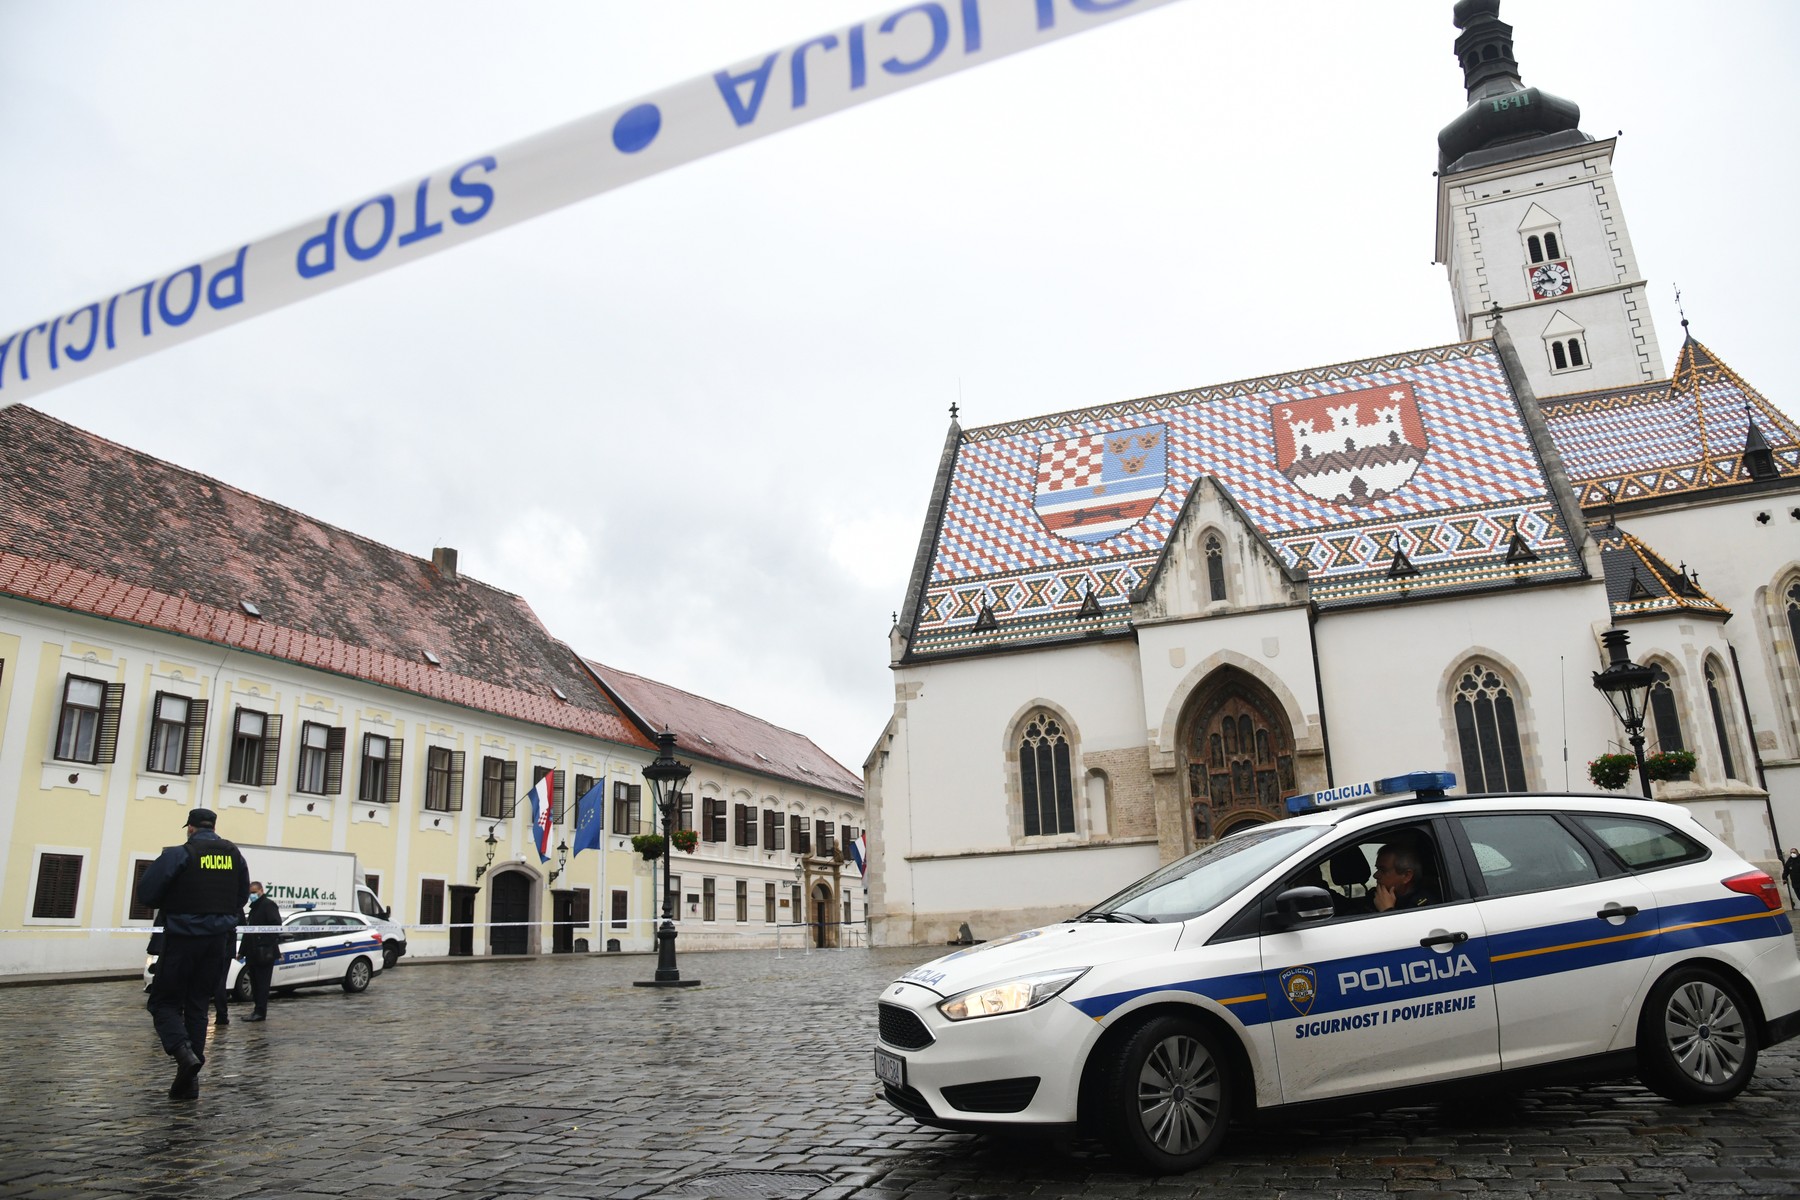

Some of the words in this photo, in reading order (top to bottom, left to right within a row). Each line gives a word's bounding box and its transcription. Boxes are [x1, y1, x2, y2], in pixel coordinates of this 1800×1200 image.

[1491, 93, 1530, 113] 1841
[297, 155, 498, 279] STOP
[1316, 782, 1372, 804] POLICIJA
[200, 854, 233, 870] POLICIJA
[265, 882, 319, 899] ŽITNJAK
[289, 950, 318, 961] POLICIJA
[1282, 968, 1314, 979] POLICIJA
[1337, 953, 1478, 995] POLICIJA
[1295, 1011, 1380, 1039] SIGURNOST
[1382, 1010, 1388, 1025] I
[1391, 995, 1476, 1022] POVJERENJE
